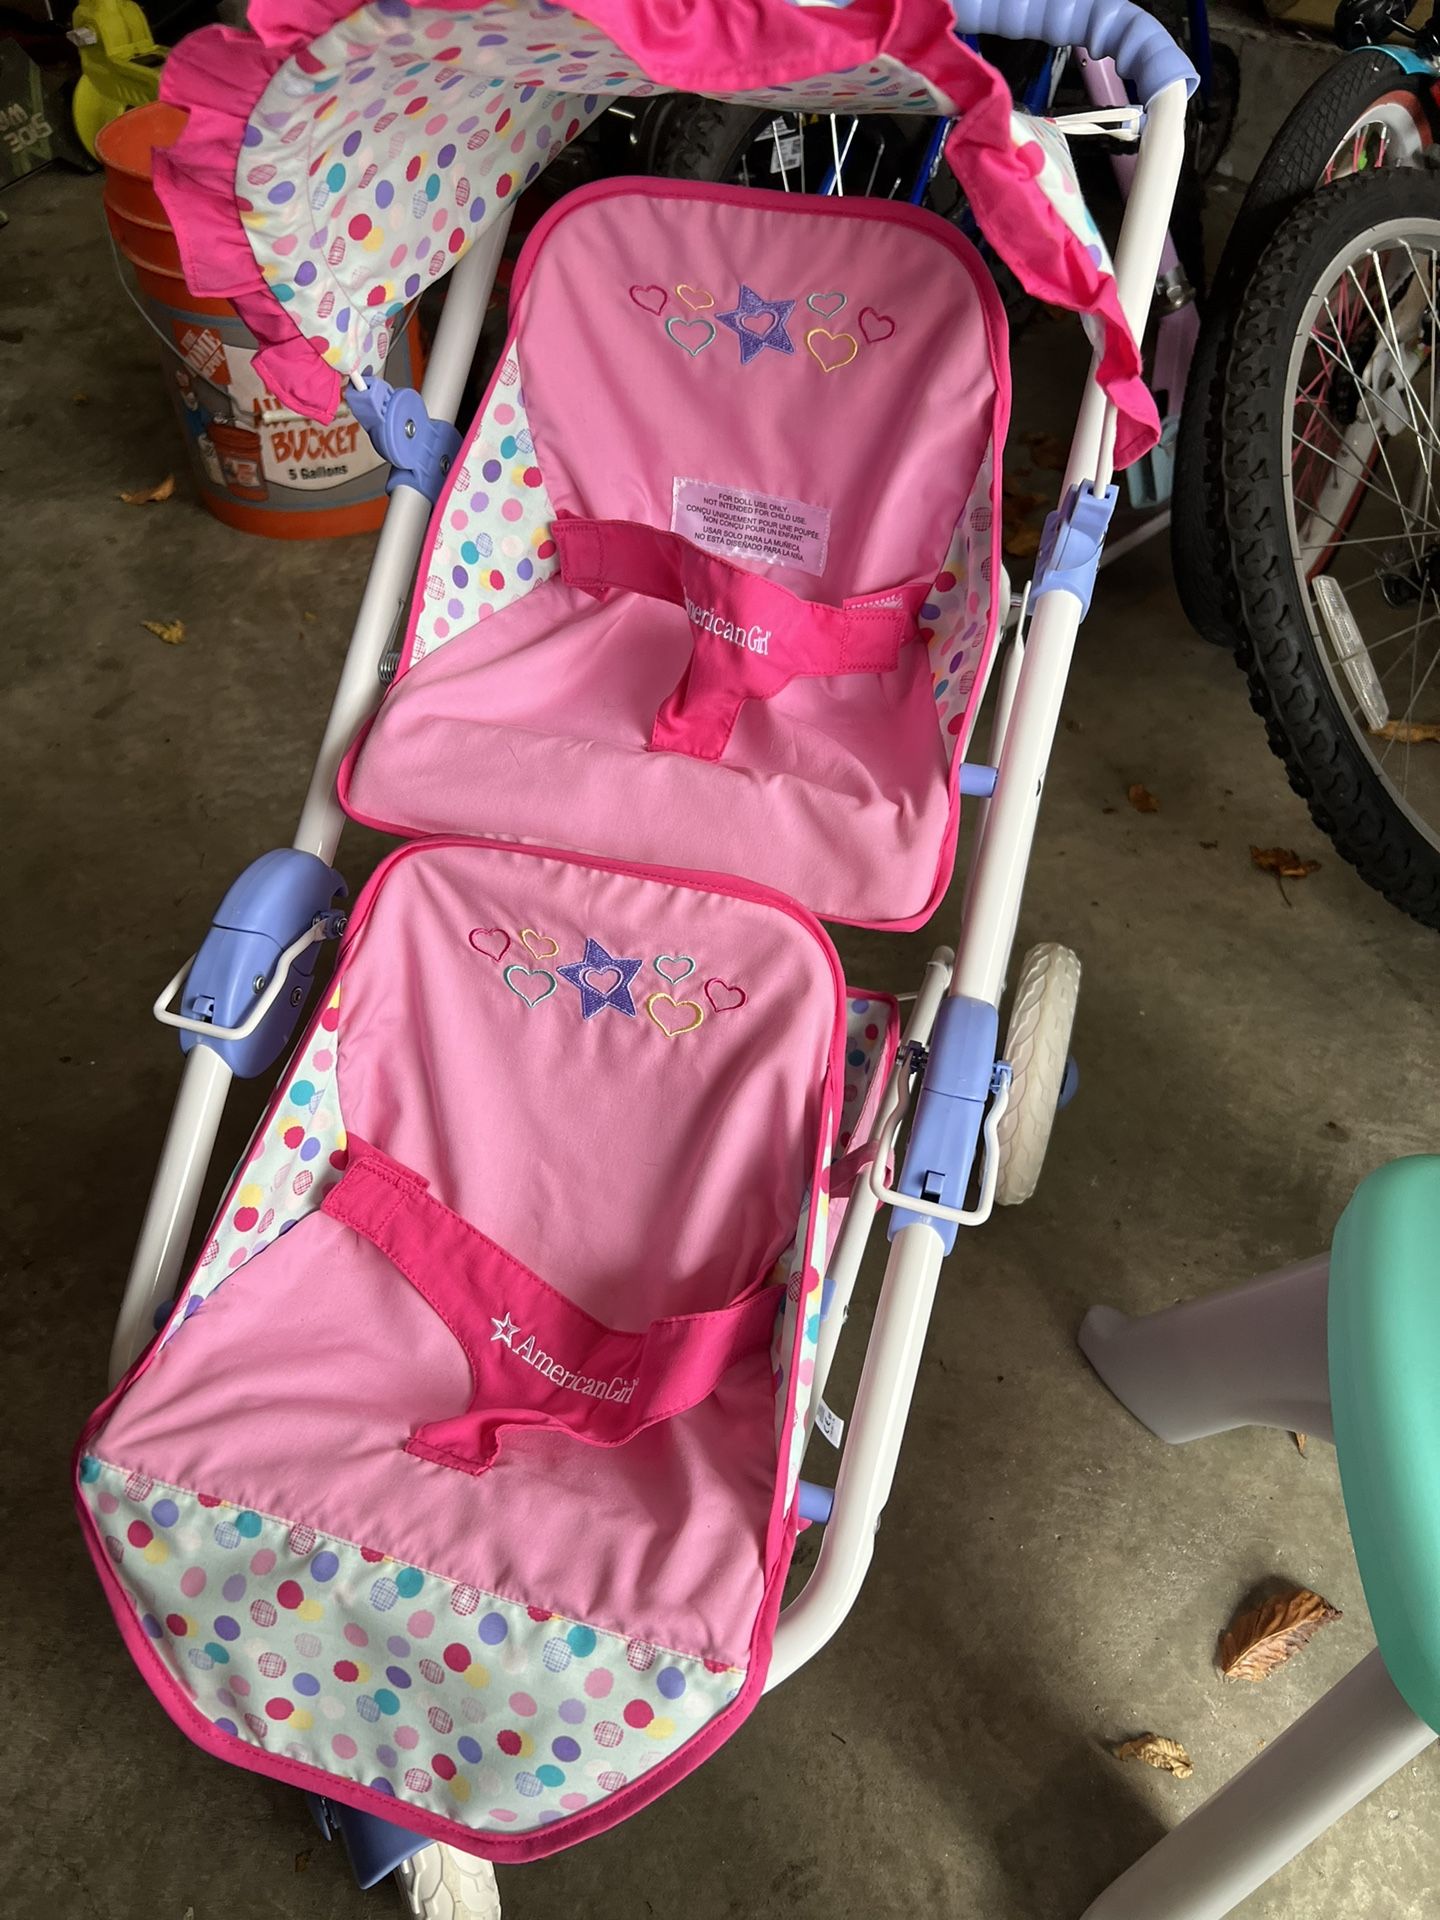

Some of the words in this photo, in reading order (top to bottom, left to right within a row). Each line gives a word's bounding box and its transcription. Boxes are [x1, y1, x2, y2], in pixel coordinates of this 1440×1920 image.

[3, 112, 52, 153] 305
[271, 422, 359, 464] BUCKET
[288, 468, 297, 480] 5
[300, 465, 348, 481] Gallons
[703, 498, 718, 506] NOT
[718, 502, 754, 514] INTENDED
[754, 508, 769, 517] FOR
[770, 511, 791, 521] CHILD
[718, 493, 733, 502] FOR
[734, 496, 753, 507] DOLL
[753, 500, 768, 509] USE
[769, 504, 789, 514] ONLY.
[686, 504, 712, 516] CONÇU
[712, 510, 757, 525] UNIQUEMENT
[758, 519, 778, 529] POUR
[779, 524, 793, 533] UNE
[703, 515, 719, 525] NON
[719, 519, 744, 531] CONÇU
[745, 525, 766, 534] POUR
[766, 528, 777, 536] UN
[694, 532, 706, 541] NO
[706, 535, 725, 545] ESTÁ
[726, 538, 763, 552] DISEÑADO
[763, 545, 782, 555] PARA
[782, 549, 790, 557] LA
[703, 526, 722, 536] USAR
[723, 530, 743, 539] SOLO
[744, 534, 763, 543] PARA
[763, 537, 773, 546] LA
